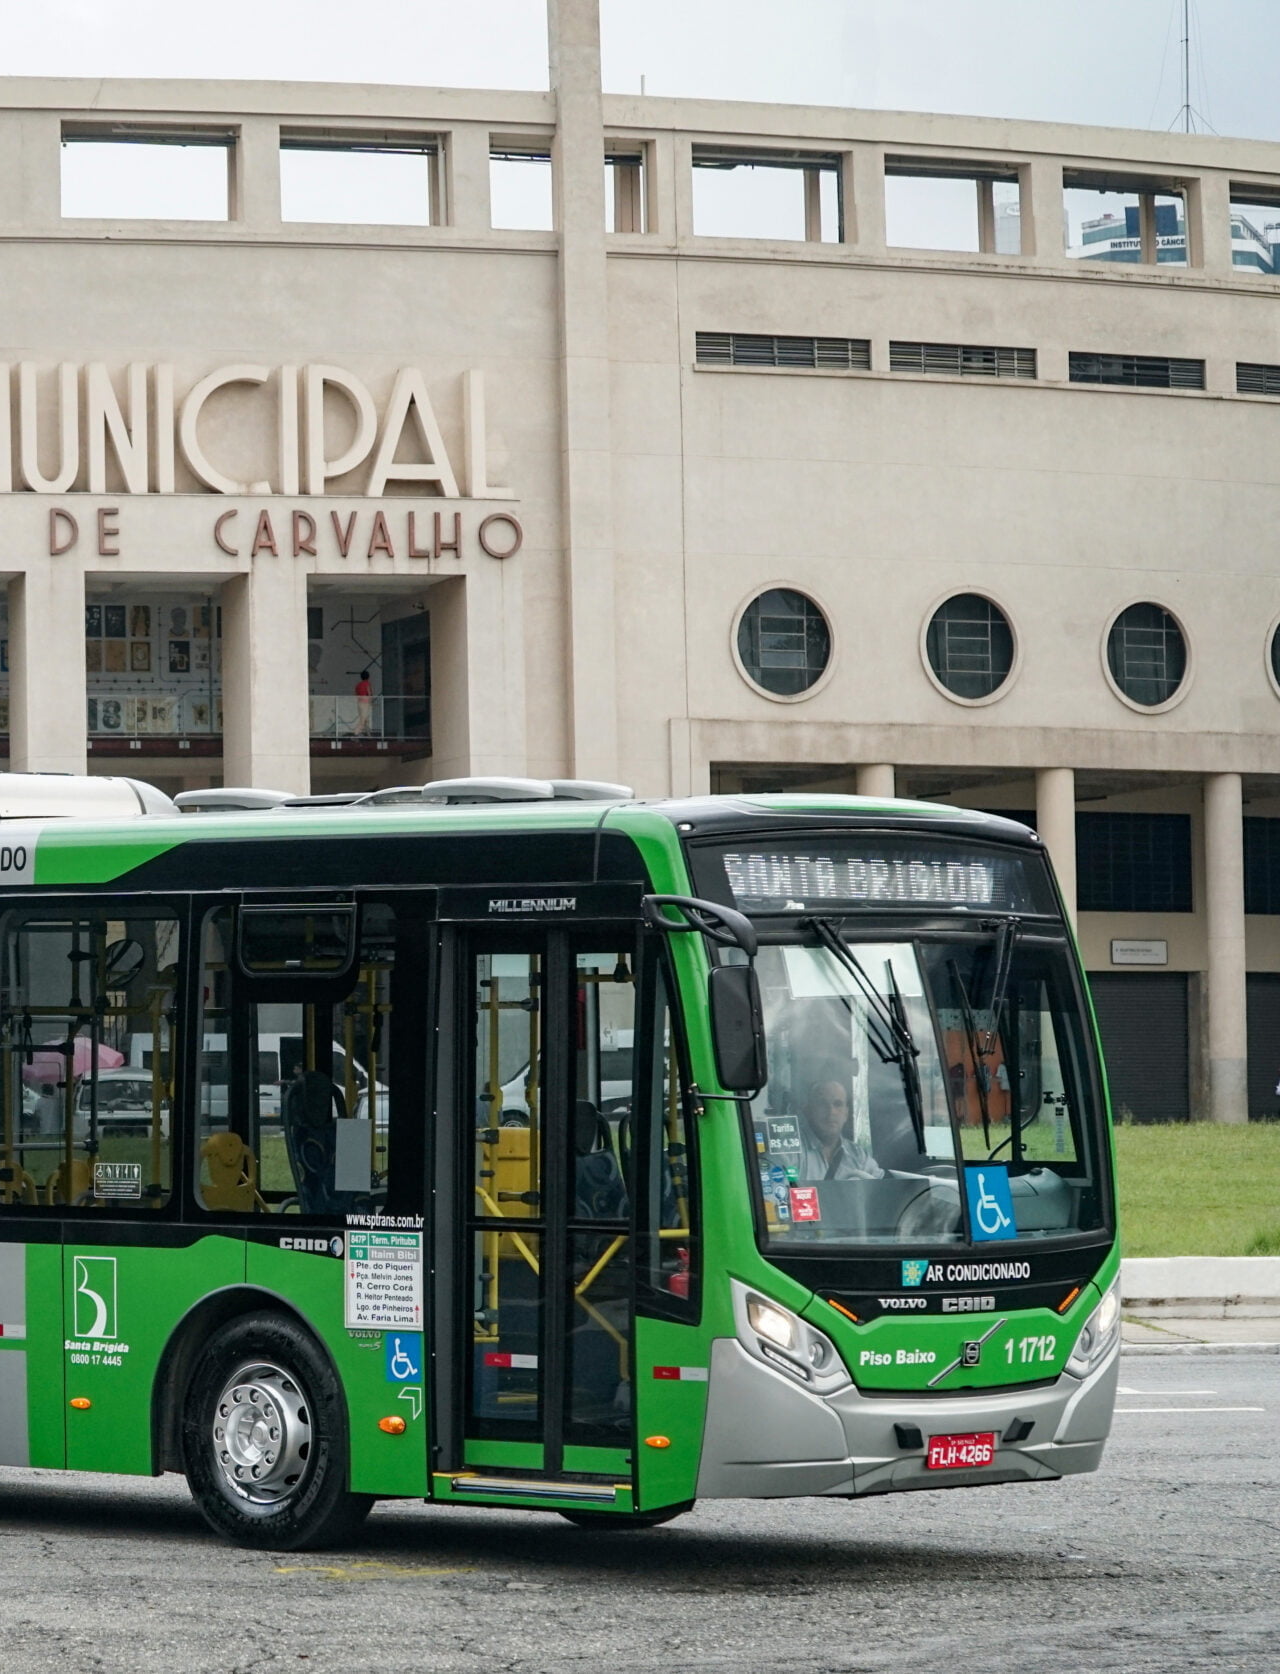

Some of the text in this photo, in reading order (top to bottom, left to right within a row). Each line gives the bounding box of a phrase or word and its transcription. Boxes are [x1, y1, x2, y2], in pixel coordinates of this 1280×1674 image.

[1161, 238, 1185, 246] CÂNCE
[50, 507, 120, 555] DE
[214, 509, 523, 558] CARVALHO
[723, 854, 836, 897] SANTA
[488, 897, 576, 913] MILLENNIUM
[346, 1213, 424, 1229] www.sptrans.com.br
[279, 1238, 328, 1251] CAIO
[350, 1235, 417, 1246] 847P Term. Pirituba
[355, 1249, 417, 1260] 10 Itaim Bibi
[385, 1263, 414, 1272] Piqueri
[926, 1262, 1030, 1282] AR CONDICIONADO
[371, 1272, 392, 1280] Melvin
[394, 1274, 413, 1282] Jones
[366, 1282, 390, 1290] Cerro
[392, 1283, 414, 1292] Corá
[384, 1294, 414, 1302] Penteado
[356, 1303, 371, 1312] Lgo.
[382, 1304, 414, 1312] Pinheiros
[878, 1296, 996, 1312] VOLVO CAIO
[357, 1313, 414, 1323] Av. Faria Lima
[348, 1330, 382, 1339] VOLVO
[64, 1340, 91, 1351] Santa
[1004, 1335, 1056, 1364] 1 1712
[71, 1353, 122, 1366] 0800 17 4445
[860, 1349, 936, 1366] Piso Baixo
